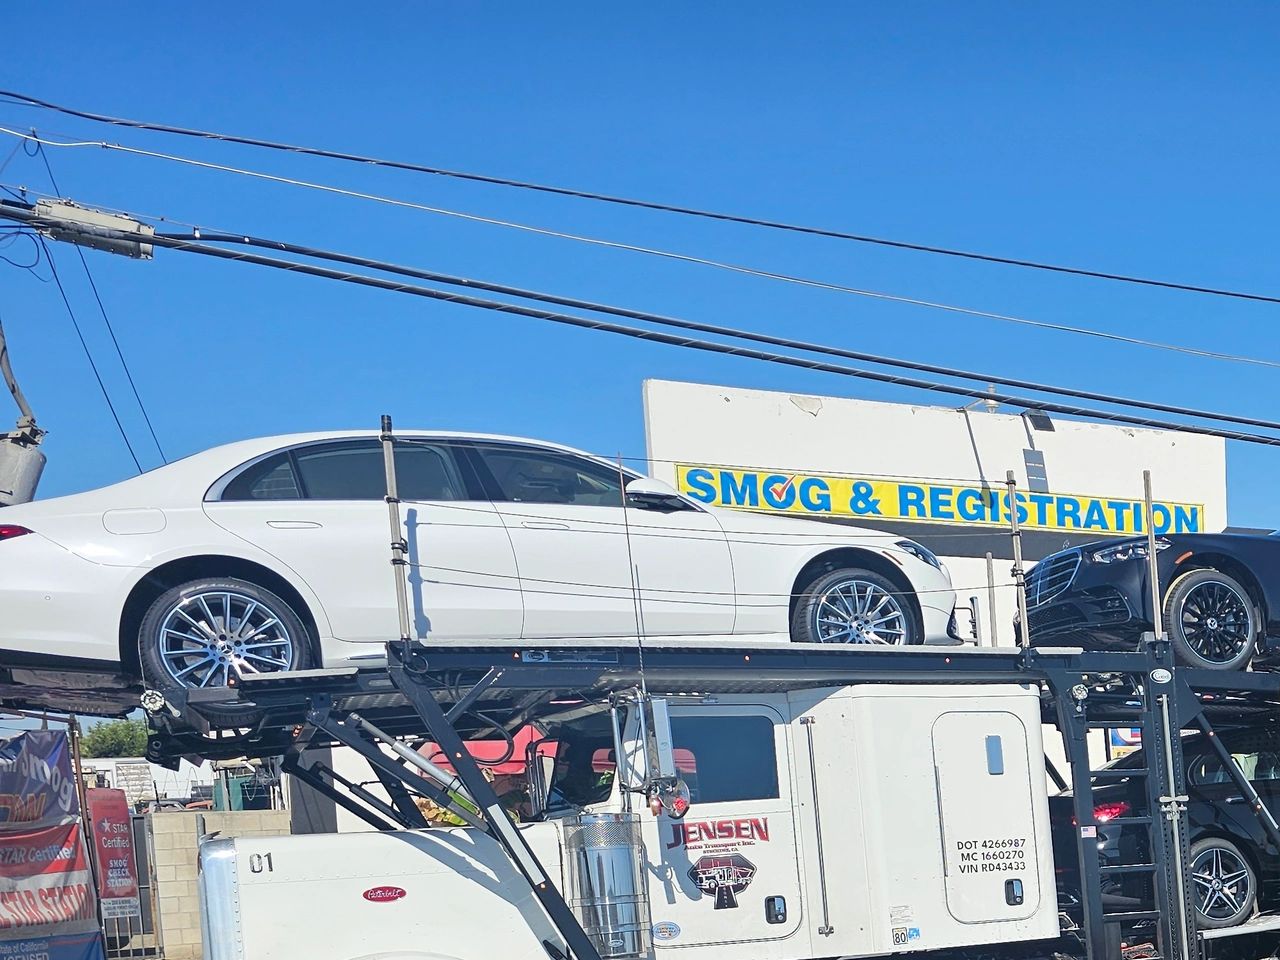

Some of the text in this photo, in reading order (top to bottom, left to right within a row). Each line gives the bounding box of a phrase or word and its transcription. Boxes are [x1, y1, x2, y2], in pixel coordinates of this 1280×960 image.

[686, 469, 1199, 534] SMOG & REGISTRATION
[113, 824, 128, 833] STAR
[666, 817, 770, 850] JENSEN
[102, 837, 130, 848] Certified
[957, 839, 1026, 850] DOT 4266987
[28, 843, 76, 862] Certified
[961, 850, 1024, 861] MC 1660270
[249, 852, 274, 873] 01
[958, 861, 1026, 873] VIN RD43433
[895, 932, 906, 943] 80
